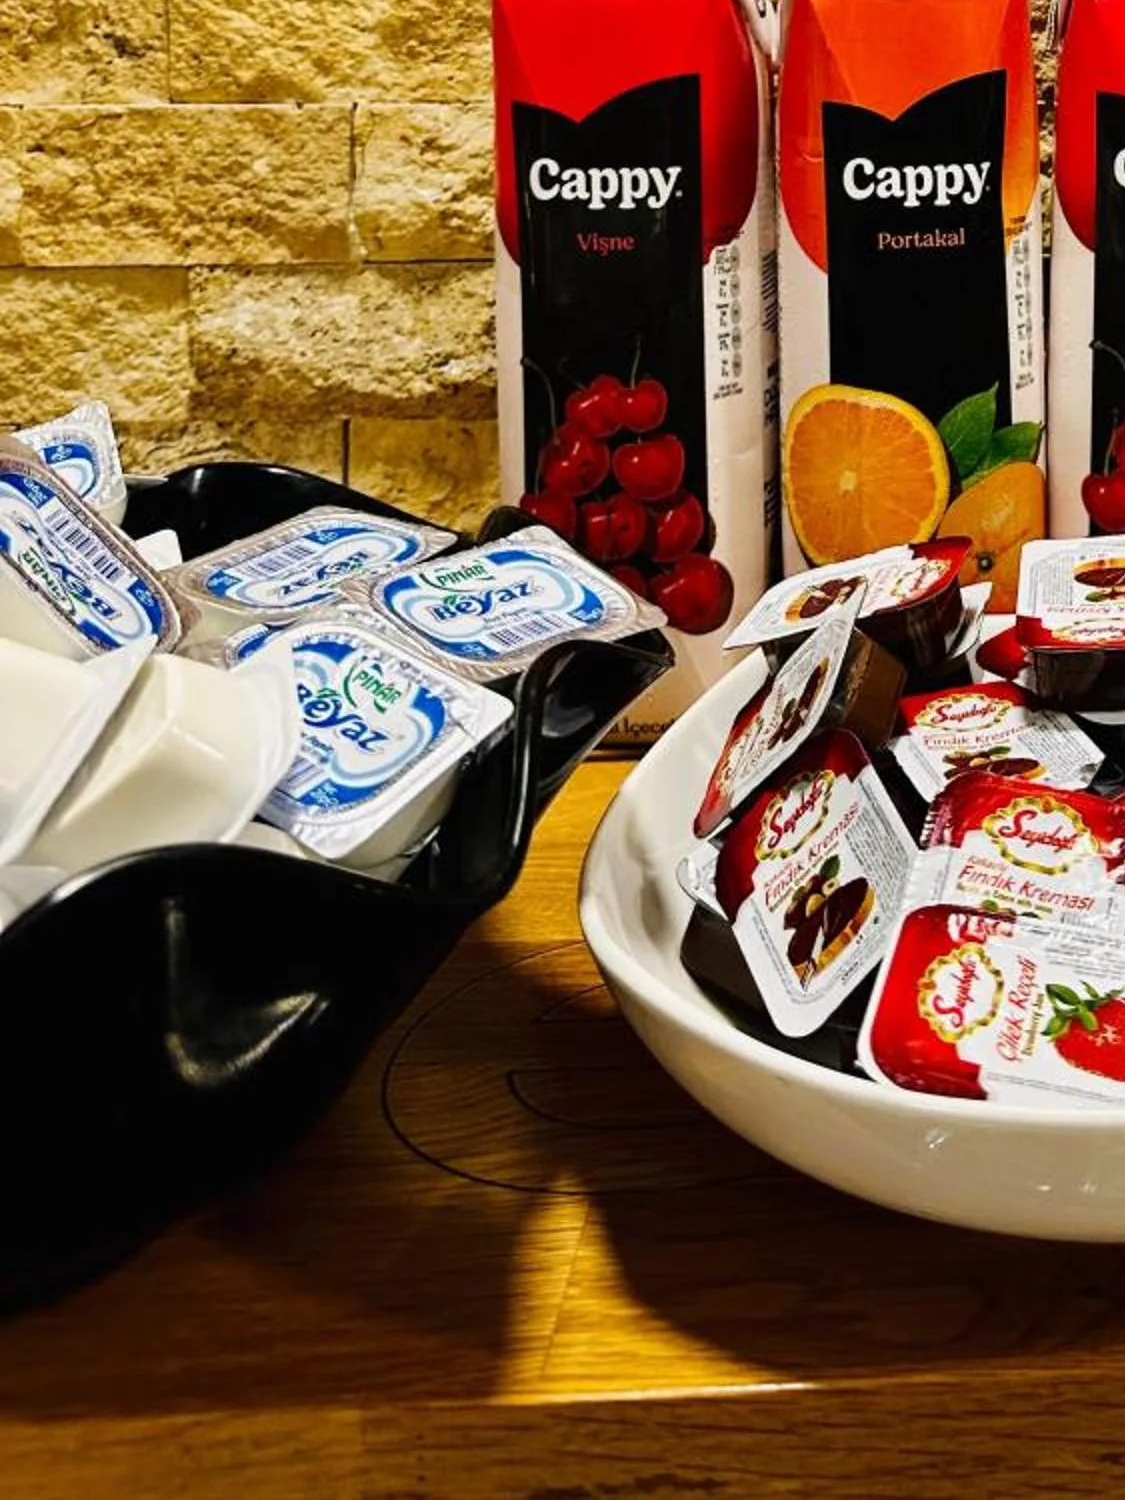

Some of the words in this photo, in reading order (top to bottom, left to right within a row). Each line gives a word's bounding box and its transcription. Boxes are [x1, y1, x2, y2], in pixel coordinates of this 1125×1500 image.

[529, 157, 682, 209] Cappy
[843, 157, 991, 208] Cappy
[575, 231, 635, 257] Vişne
[876, 228, 966, 251] Portakal
